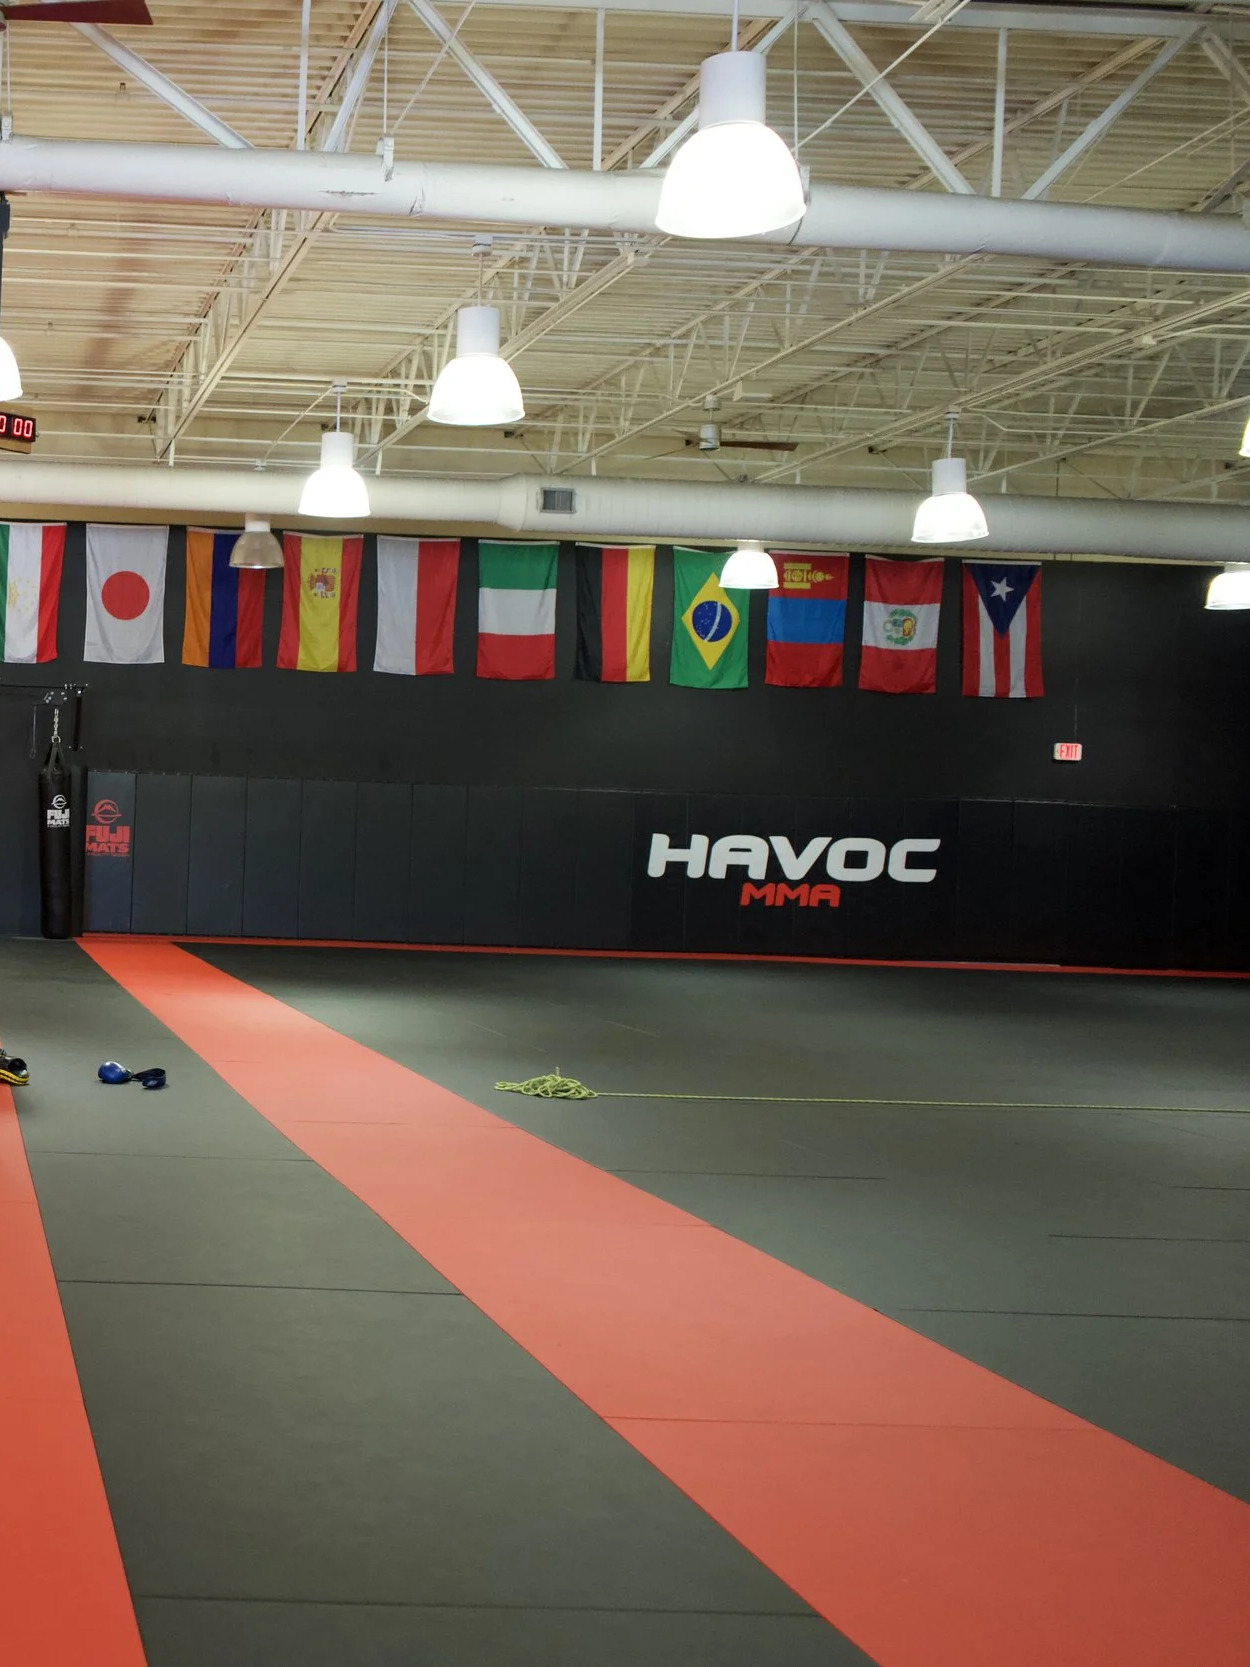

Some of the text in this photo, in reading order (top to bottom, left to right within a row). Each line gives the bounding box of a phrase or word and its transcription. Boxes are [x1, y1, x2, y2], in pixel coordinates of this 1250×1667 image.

[13, 417, 34, 438] 00
[1059, 744, 1079, 759] EXIT
[47, 808, 70, 820] FUJI
[85, 825, 130, 843] FUJI
[85, 842, 130, 853] MATS
[646, 832, 941, 884] HAVOC
[739, 882, 841, 908] MMA
